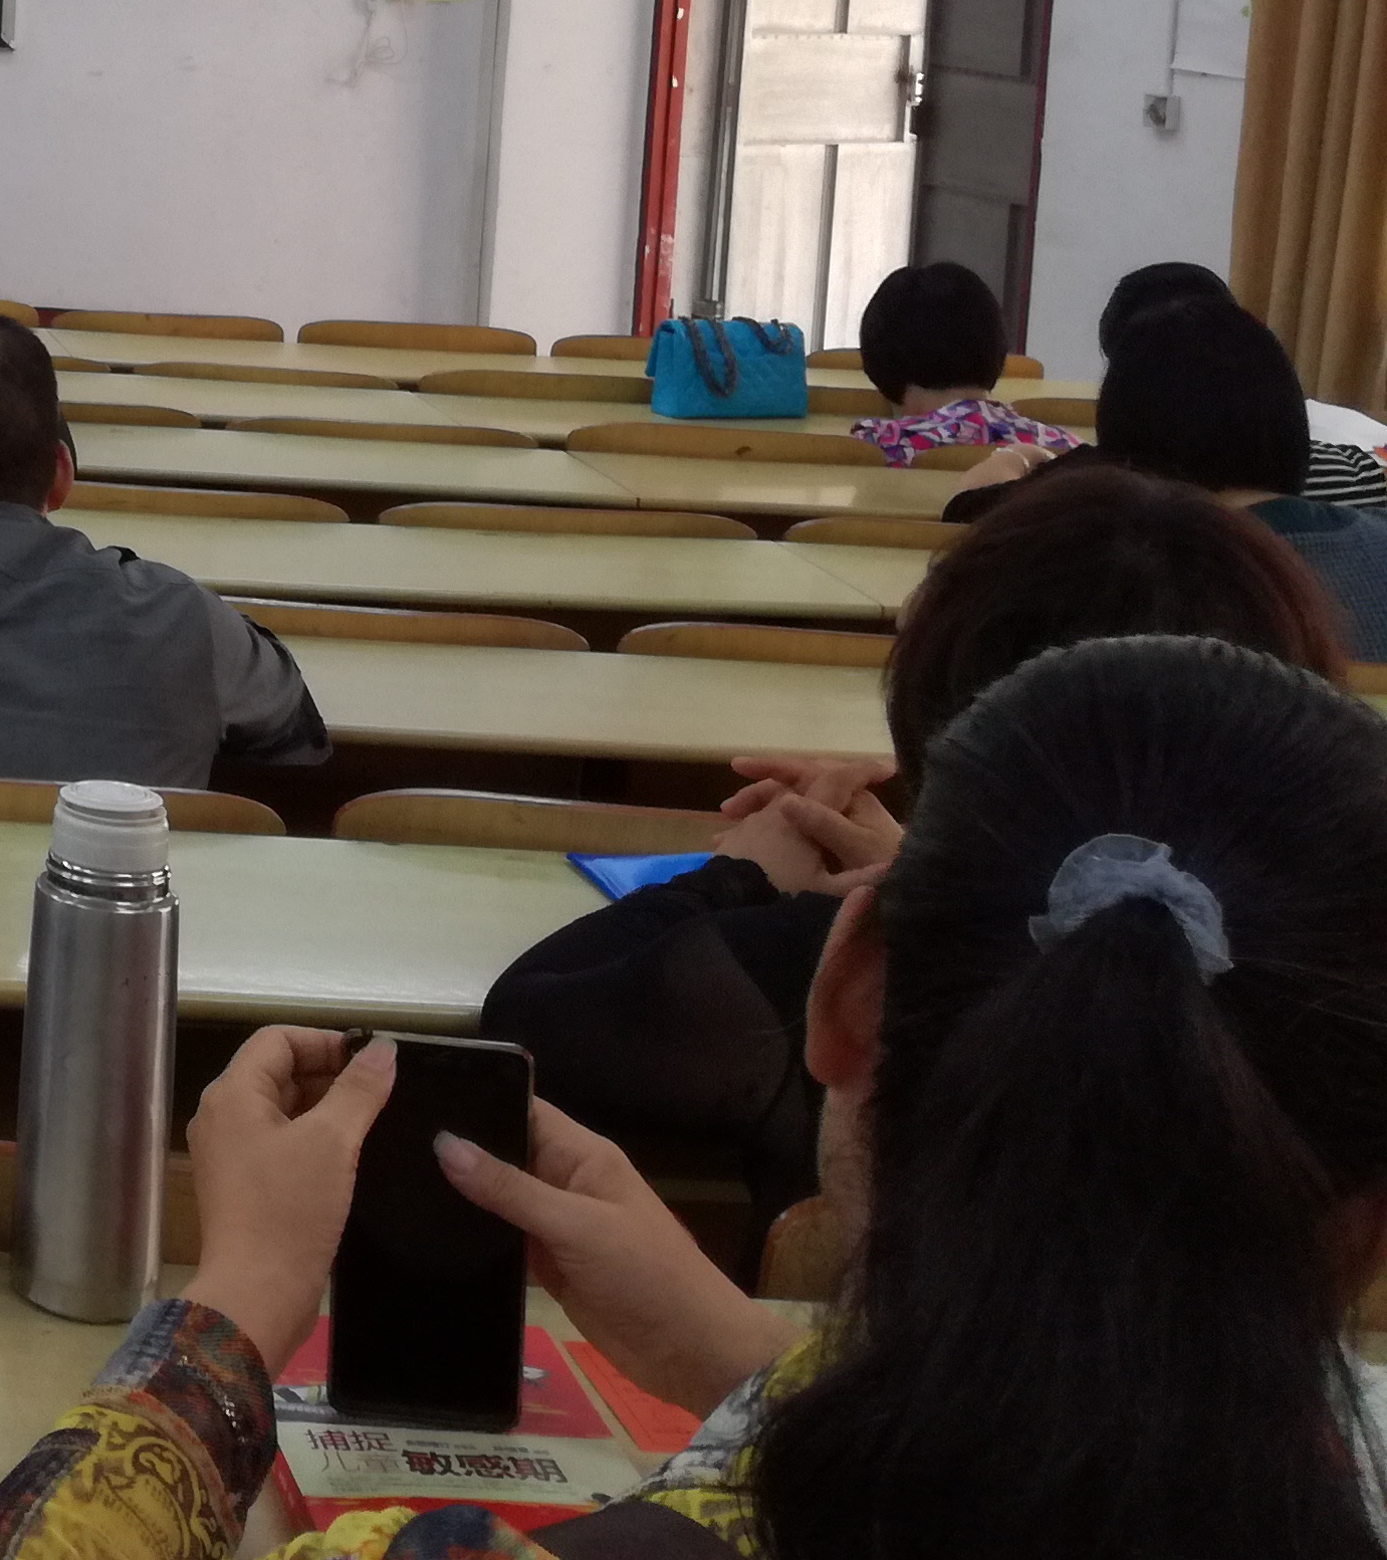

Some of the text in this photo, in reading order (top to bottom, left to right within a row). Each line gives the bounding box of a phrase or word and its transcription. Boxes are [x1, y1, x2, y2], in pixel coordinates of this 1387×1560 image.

[306, 1429, 398, 1452] 捕捉
[320, 1449, 568, 1484] 儿童敏感期
